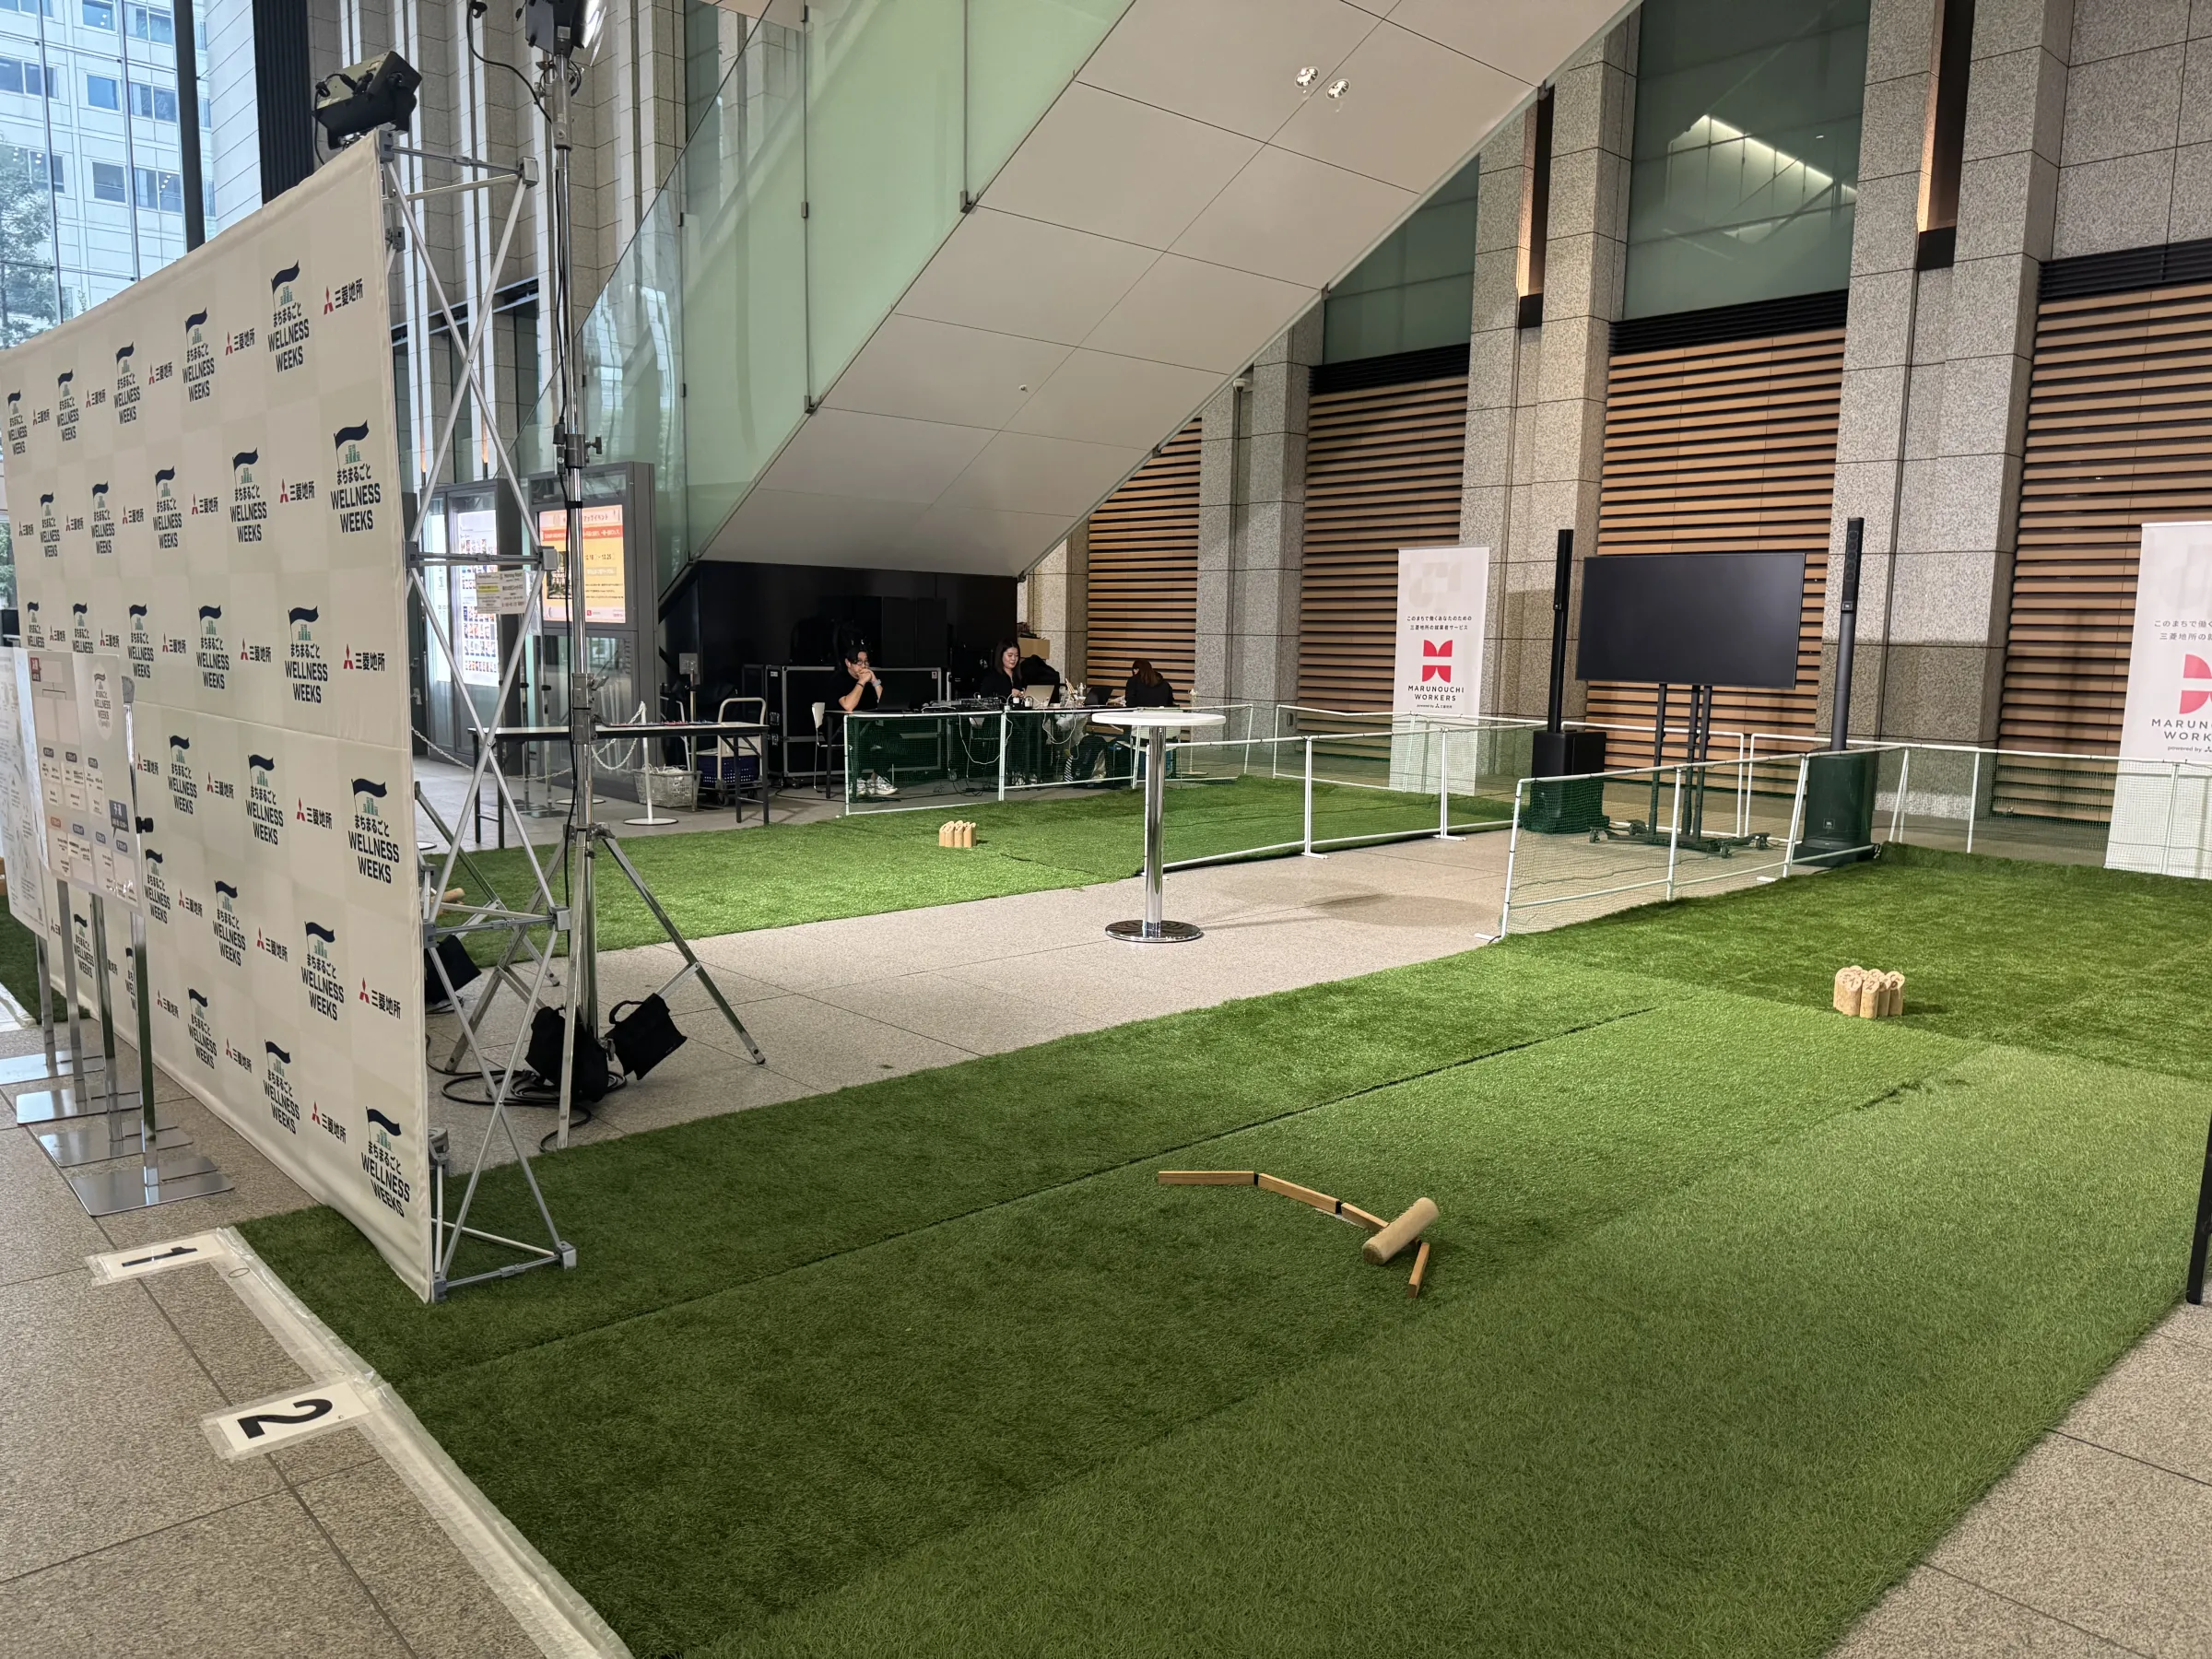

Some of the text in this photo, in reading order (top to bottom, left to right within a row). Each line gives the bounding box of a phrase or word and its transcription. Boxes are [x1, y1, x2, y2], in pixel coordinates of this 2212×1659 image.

[335, 278, 362, 308] 三菱地所
[274, 302, 301, 327] まちまるごと
[268, 319, 309, 352] WELLNESS
[187, 343, 208, 363] まちまるごと
[276, 346, 303, 372] WEEKS
[182, 358, 214, 383] WELLNESS
[114, 386, 140, 408] WELLNESS
[189, 380, 209, 402] WEEKS
[57, 408, 79, 427] WELLNESS
[119, 406, 136, 424] WEEKS
[8, 426, 27, 441] WELLNESS
[337, 464, 371, 485] まちまるごと
[235, 485, 260, 501] まちまるごと
[290, 481, 314, 500] 三菱地所
[331, 483, 380, 509] WELLNESS
[157, 498, 176, 513] まちまるごと
[230, 502, 267, 522] WELLNESS
[91, 523, 114, 538] WELLNESS
[153, 513, 182, 530] WELLNESS
[340, 510, 373, 533] WEEKS
[40, 529, 60, 542] WELLNESS
[159, 533, 178, 548] WEEKS
[237, 524, 261, 542] WEEKS
[96, 540, 112, 553] WEEKS
[72, 641, 93, 653] WELLNESS
[128, 646, 154, 661] WELLNESS
[201, 637, 223, 651] まちまるごと
[291, 643, 320, 659] まちまるごと
[133, 663, 150, 678] WEEKS
[196, 652, 229, 670] WELLNESS
[285, 661, 327, 681] WELLNESS
[356, 653, 385, 671] 三菱地所
[203, 672, 224, 689] WEEKS
[293, 683, 321, 703] WEEKS
[2152, 719, 2212, 729] MARUN
[2164, 731, 2212, 741] WORK
[171, 763, 191, 779] まちまるごと
[168, 776, 197, 798] WELLNESS
[251, 786, 276, 805] まちまるごと
[174, 796, 193, 814] WEEKS
[246, 800, 283, 827] WELLNESS
[307, 808, 332, 829] 三菱地所
[355, 814, 389, 837] まちまるごと
[253, 822, 278, 845] WEEKS
[348, 831, 399, 863] WELLNESS
[358, 856, 391, 883] WEEKS
[145, 886, 170, 910] WELLNESS
[150, 904, 167, 924] WEEKS
[217, 909, 239, 930] まちまるごと
[213, 921, 245, 950] WELLNESS
[219, 941, 241, 966] WEEKS
[307, 954, 336, 979] まちまるごと
[301, 967, 344, 1003] WELLNESS
[309, 991, 337, 1020] WEEKS
[372, 990, 400, 1019] 三菱地所
[192, 1014, 211, 1036] まちまるごと
[188, 1024, 217, 1056] WELLNESS
[195, 1044, 214, 1069] WEEKS
[268, 1069, 292, 1097] まちまるごと
[263, 1080, 300, 1120] WELLNESS
[271, 1103, 296, 1134] WEEKS
[322, 1114, 346, 1143] 三菱地所
[369, 1141, 401, 1175] まちまるごと
[361, 1153, 409, 1202] WELLNESS
[371, 1180, 404, 1218] WEEKS
[122, 1247, 197, 1267] 1
[238, 1398, 333, 1439] 2
